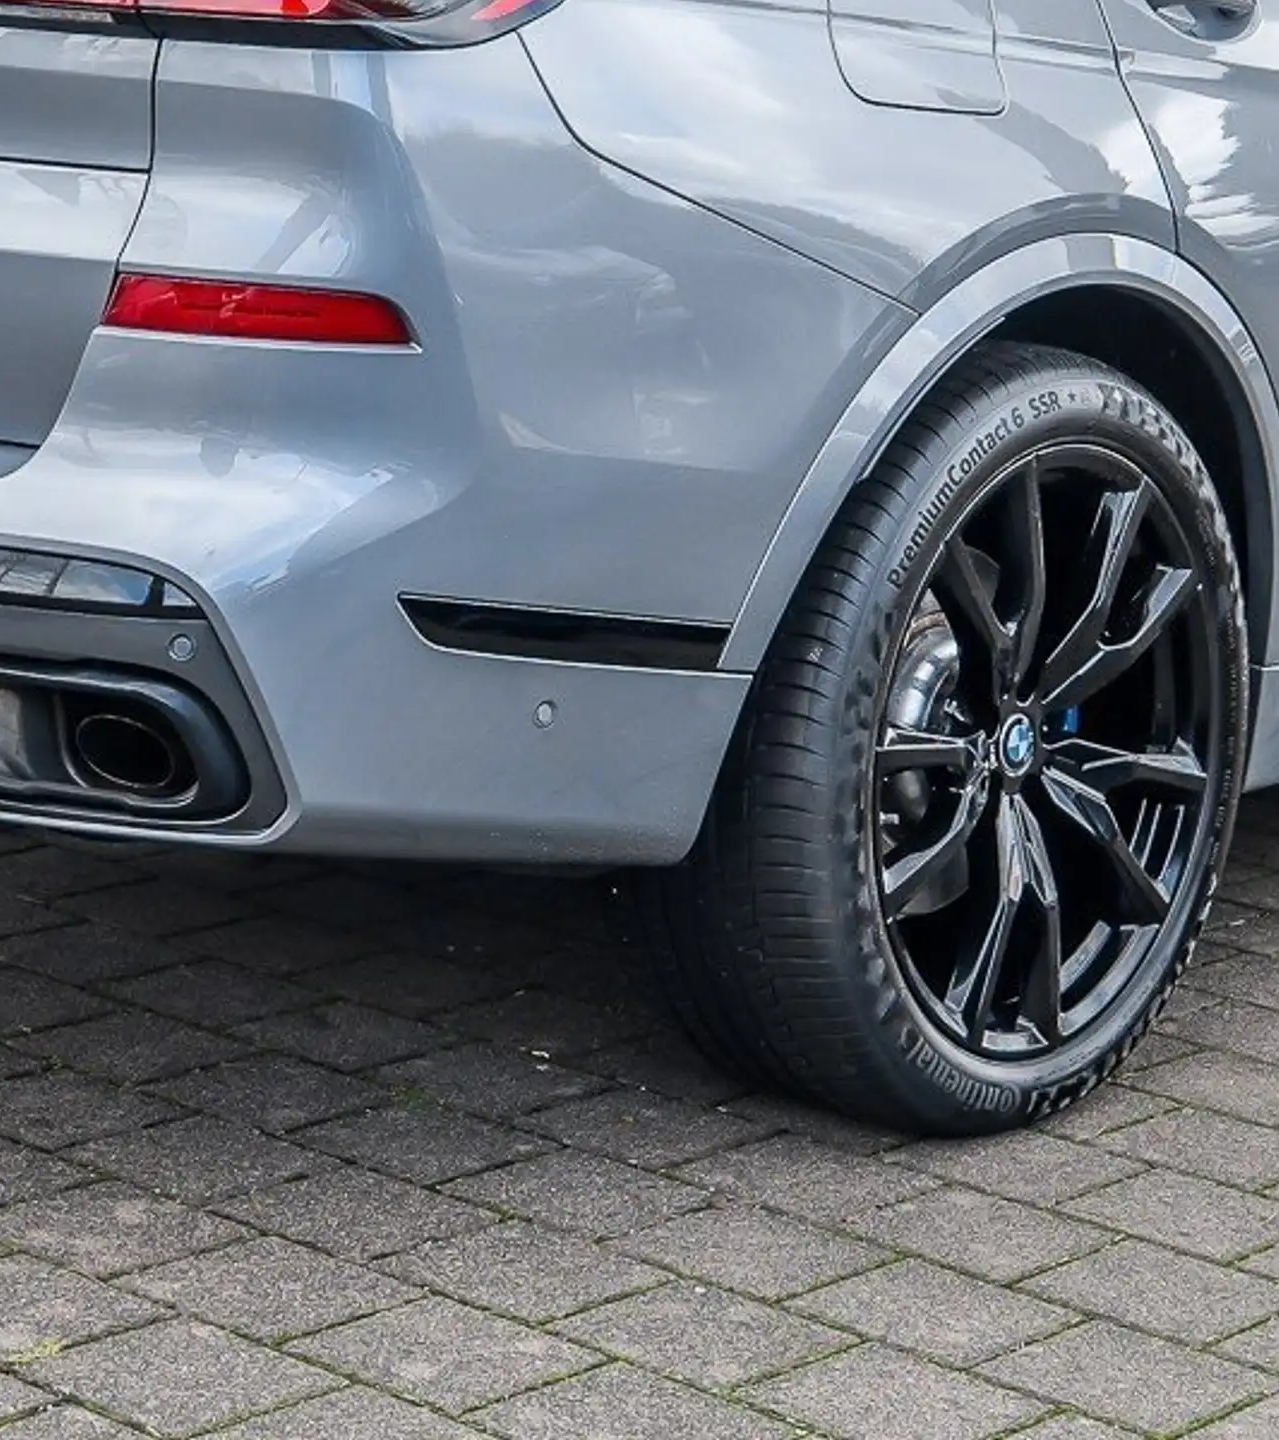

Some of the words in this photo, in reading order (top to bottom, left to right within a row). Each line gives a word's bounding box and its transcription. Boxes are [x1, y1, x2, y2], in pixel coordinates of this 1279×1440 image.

[886, 417, 1012, 590] PremiumContact
[1011, 406, 1026, 430] 6
[1028, 390, 1063, 419] SSR
